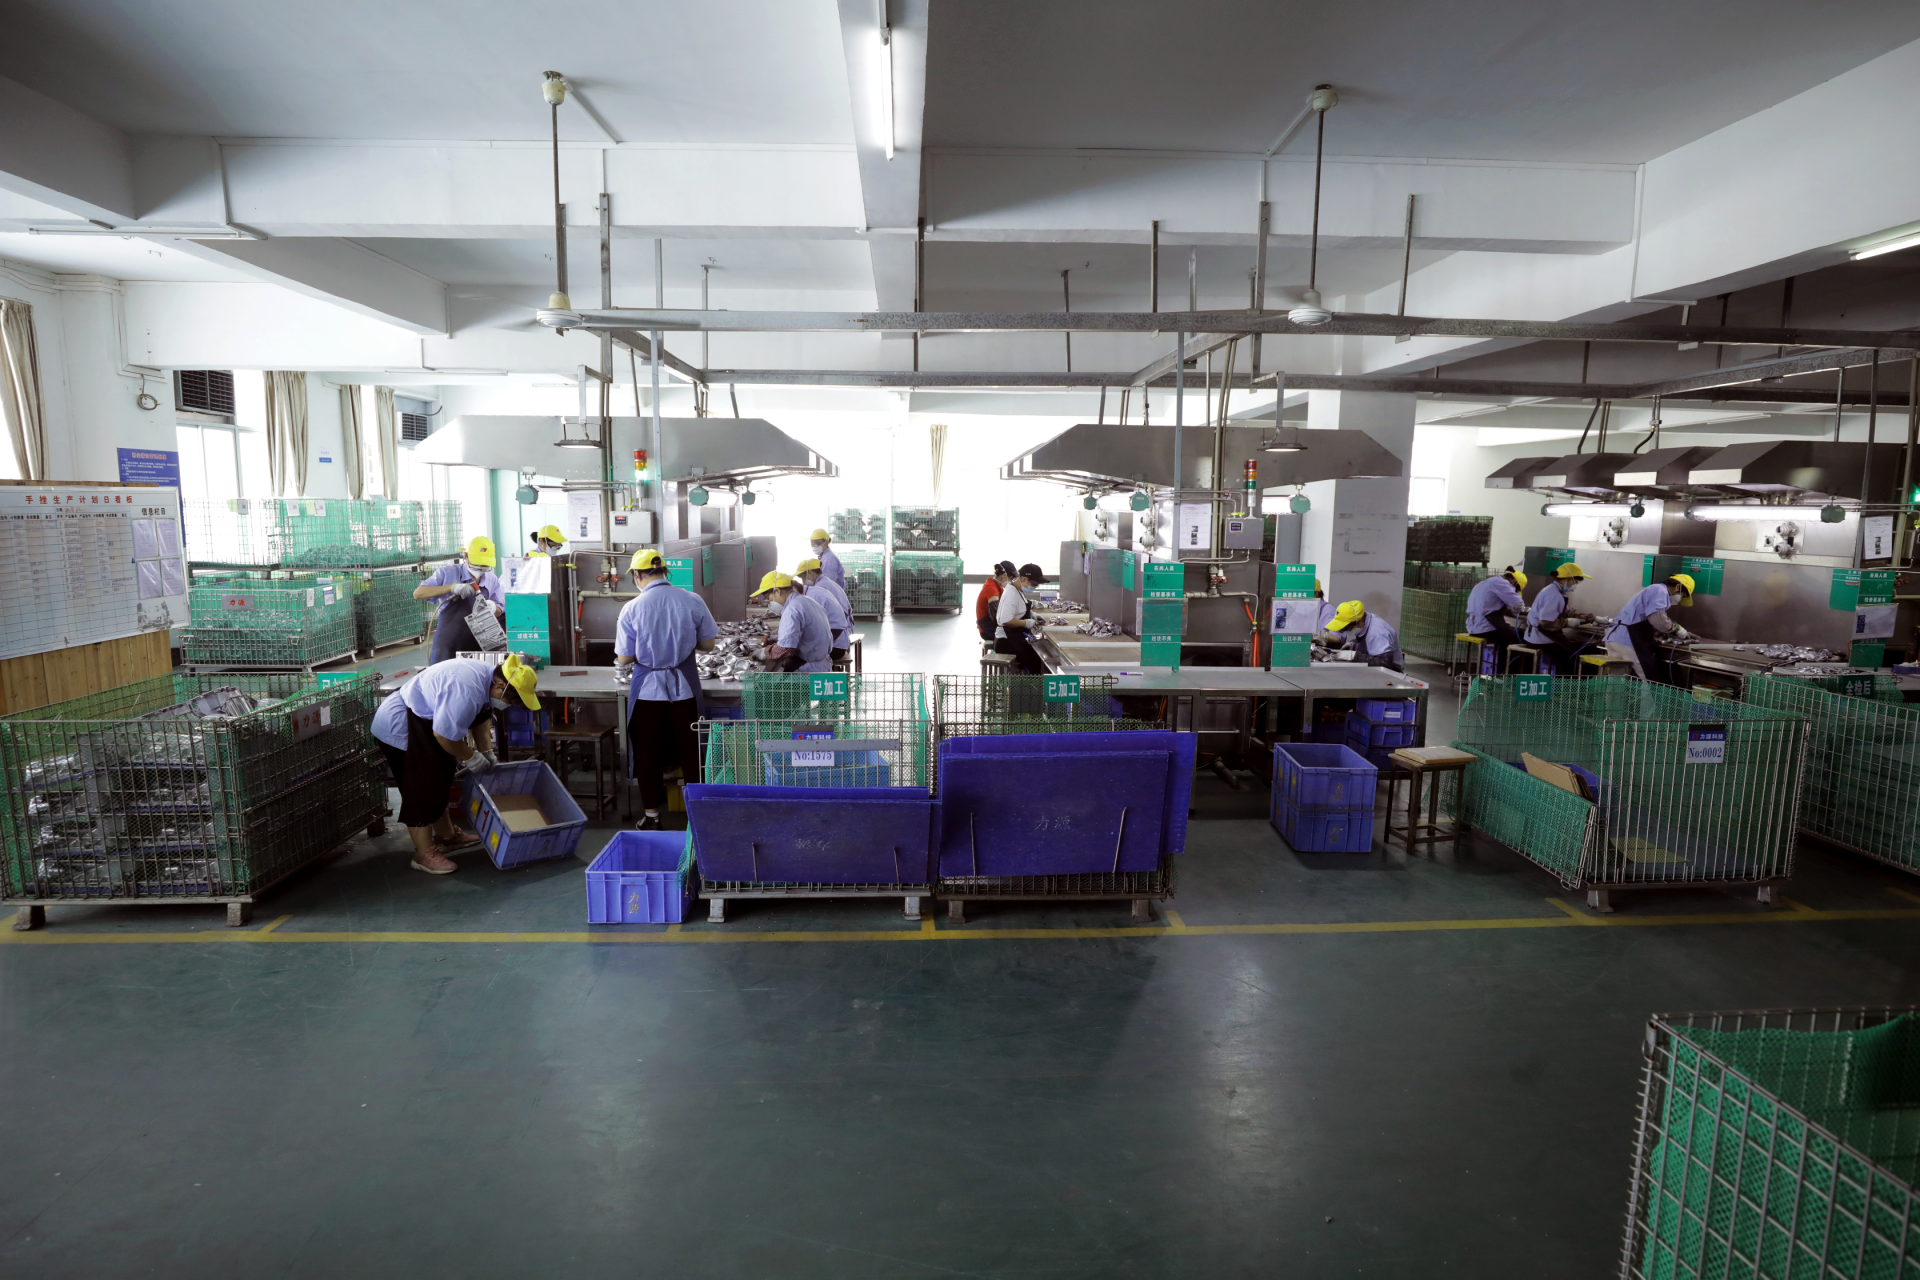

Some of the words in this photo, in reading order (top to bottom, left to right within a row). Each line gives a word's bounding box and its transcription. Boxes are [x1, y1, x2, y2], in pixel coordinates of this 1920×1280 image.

[813, 680, 844, 696] 已加工
[1048, 680, 1078, 697] 已加工
[1519, 680, 1548, 696] 已加工
[1845, 680, 1872, 696] 全检后
[794, 750, 833, 761] No:1575
[1688, 747, 1723, 759] No:0002
